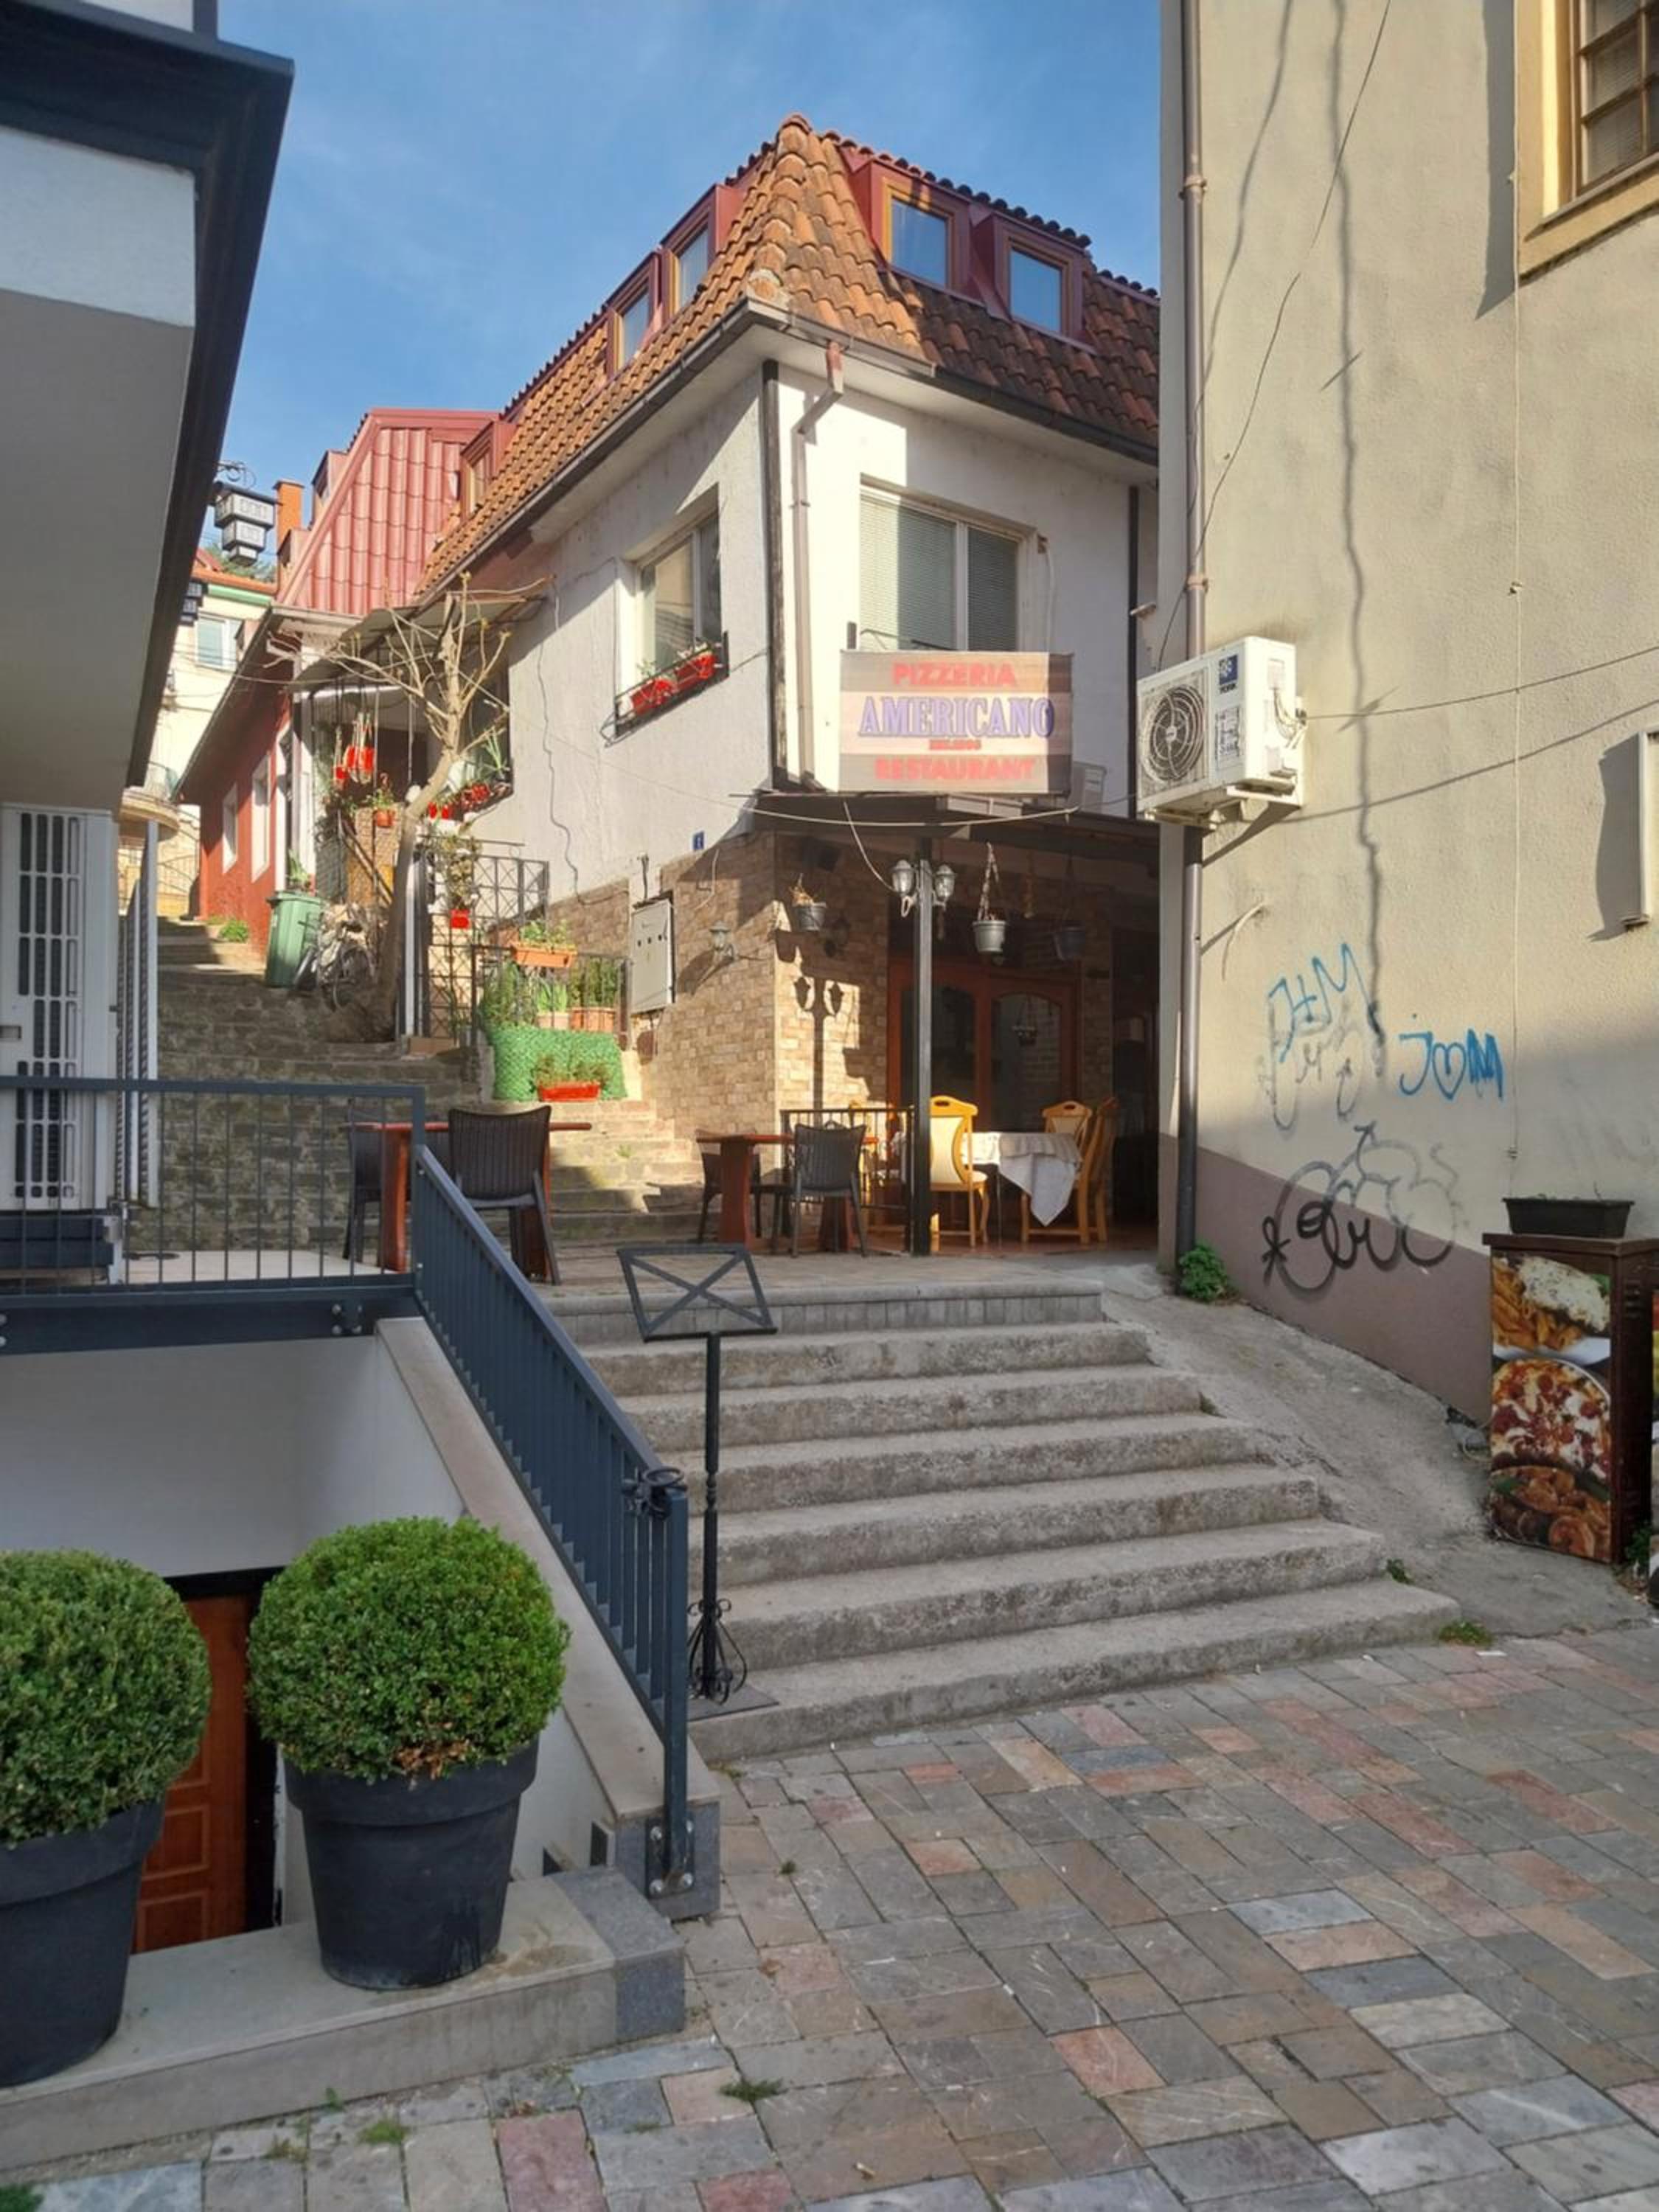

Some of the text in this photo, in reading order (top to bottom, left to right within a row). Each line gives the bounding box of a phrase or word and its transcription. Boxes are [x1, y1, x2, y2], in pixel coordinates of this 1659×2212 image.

[893, 663, 1016, 686] PIZZERIA
[858, 695, 1055, 738] AMERICANO
[875, 757, 1034, 779] RESTAURANT
